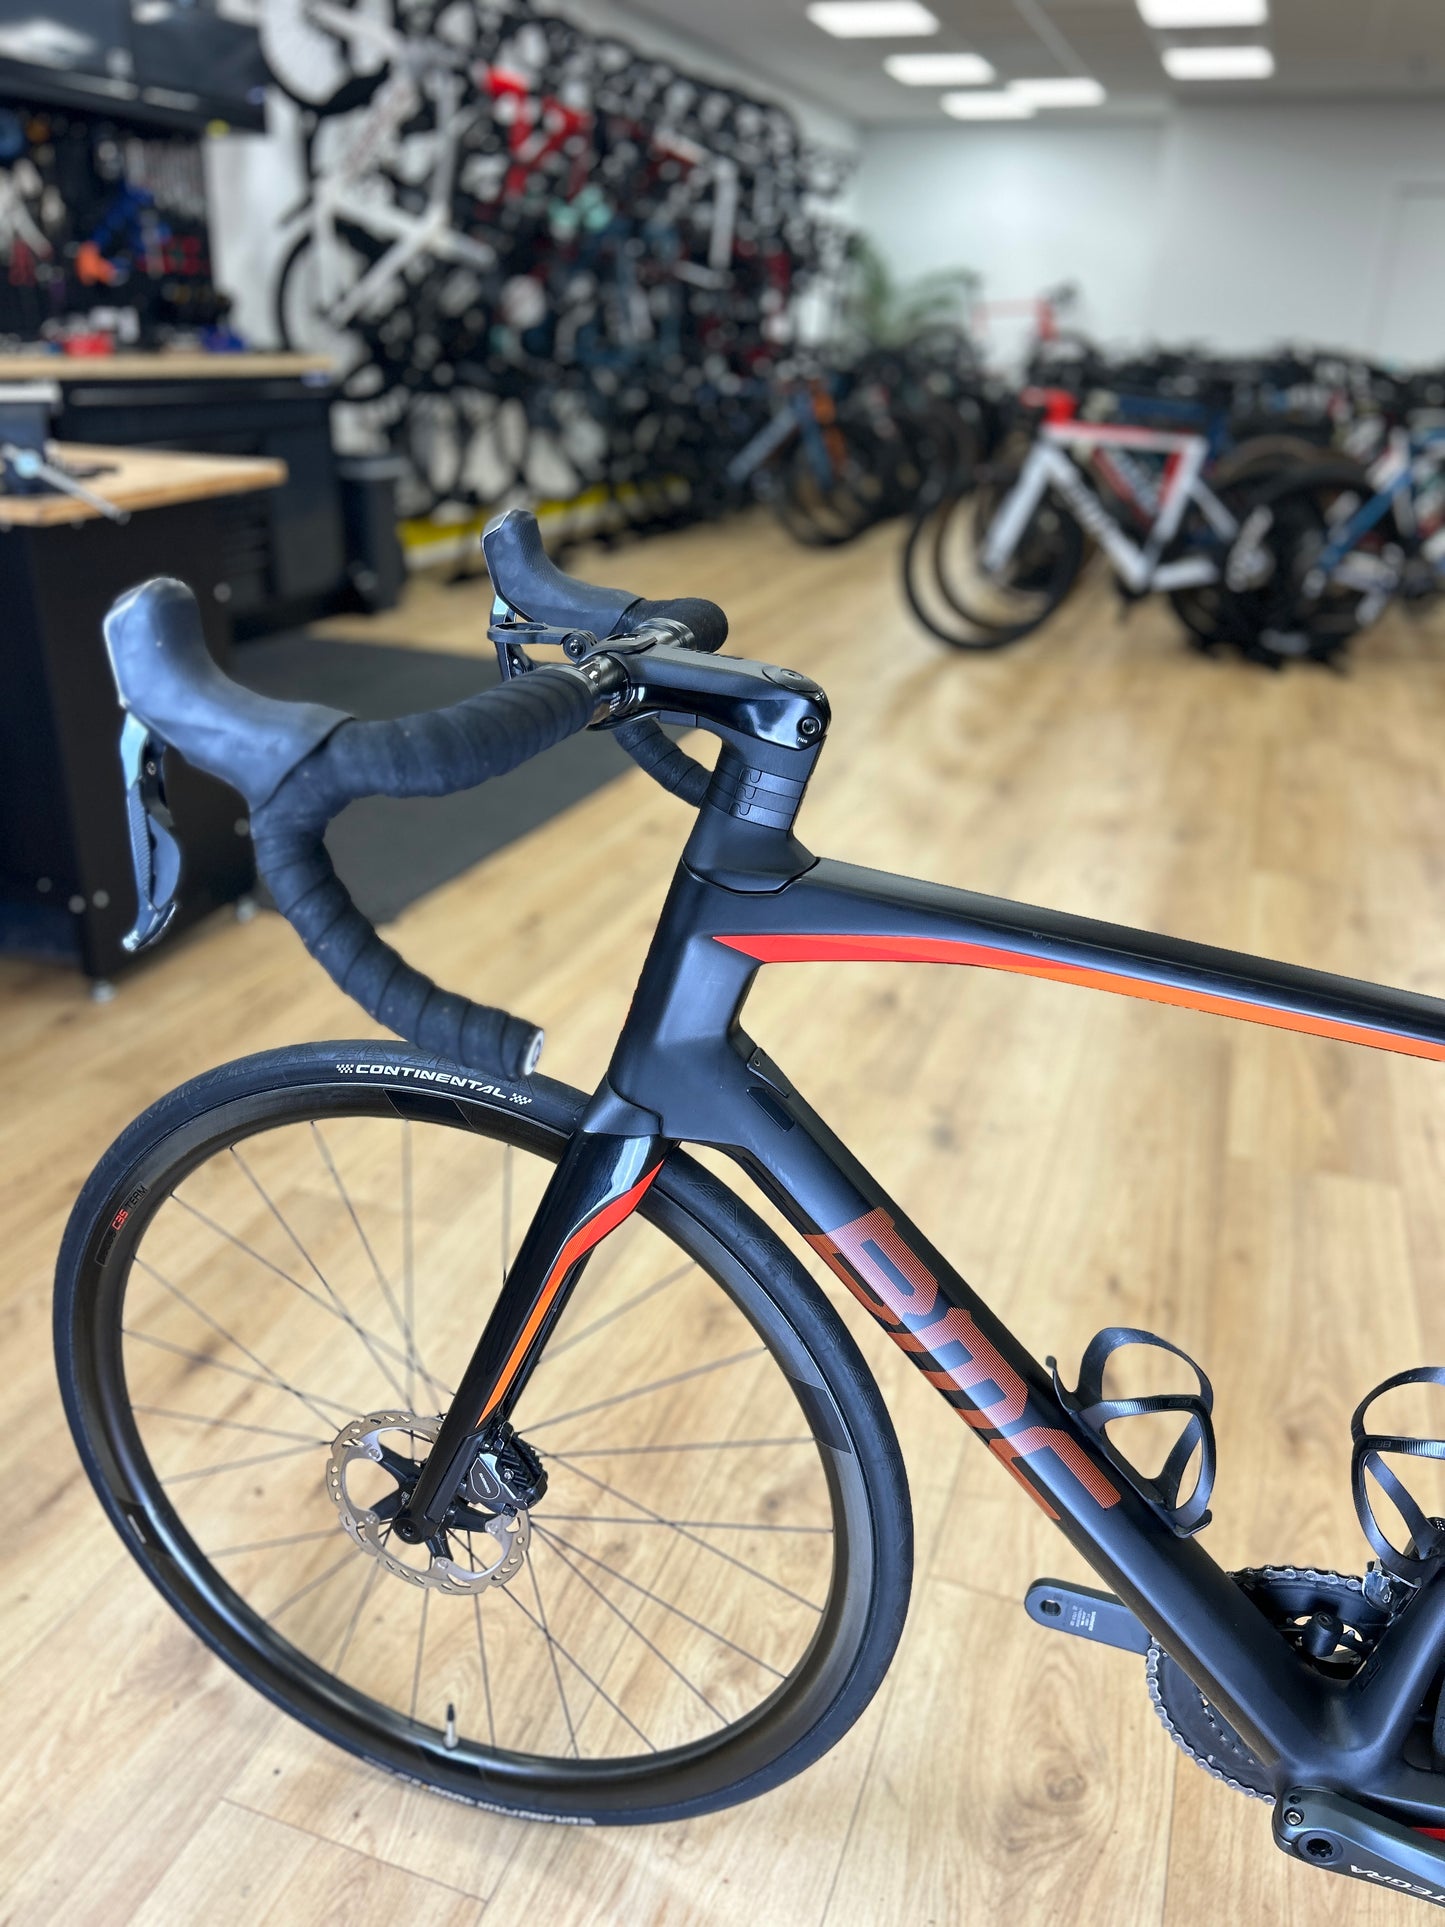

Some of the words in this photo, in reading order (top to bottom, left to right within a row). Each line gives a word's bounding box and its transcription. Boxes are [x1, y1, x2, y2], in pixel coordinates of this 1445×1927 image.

[355, 1064, 507, 1099] CONTINENTAL
[125, 1184, 148, 1209] TEAM
[802, 1206, 1122, 1520] BMC
